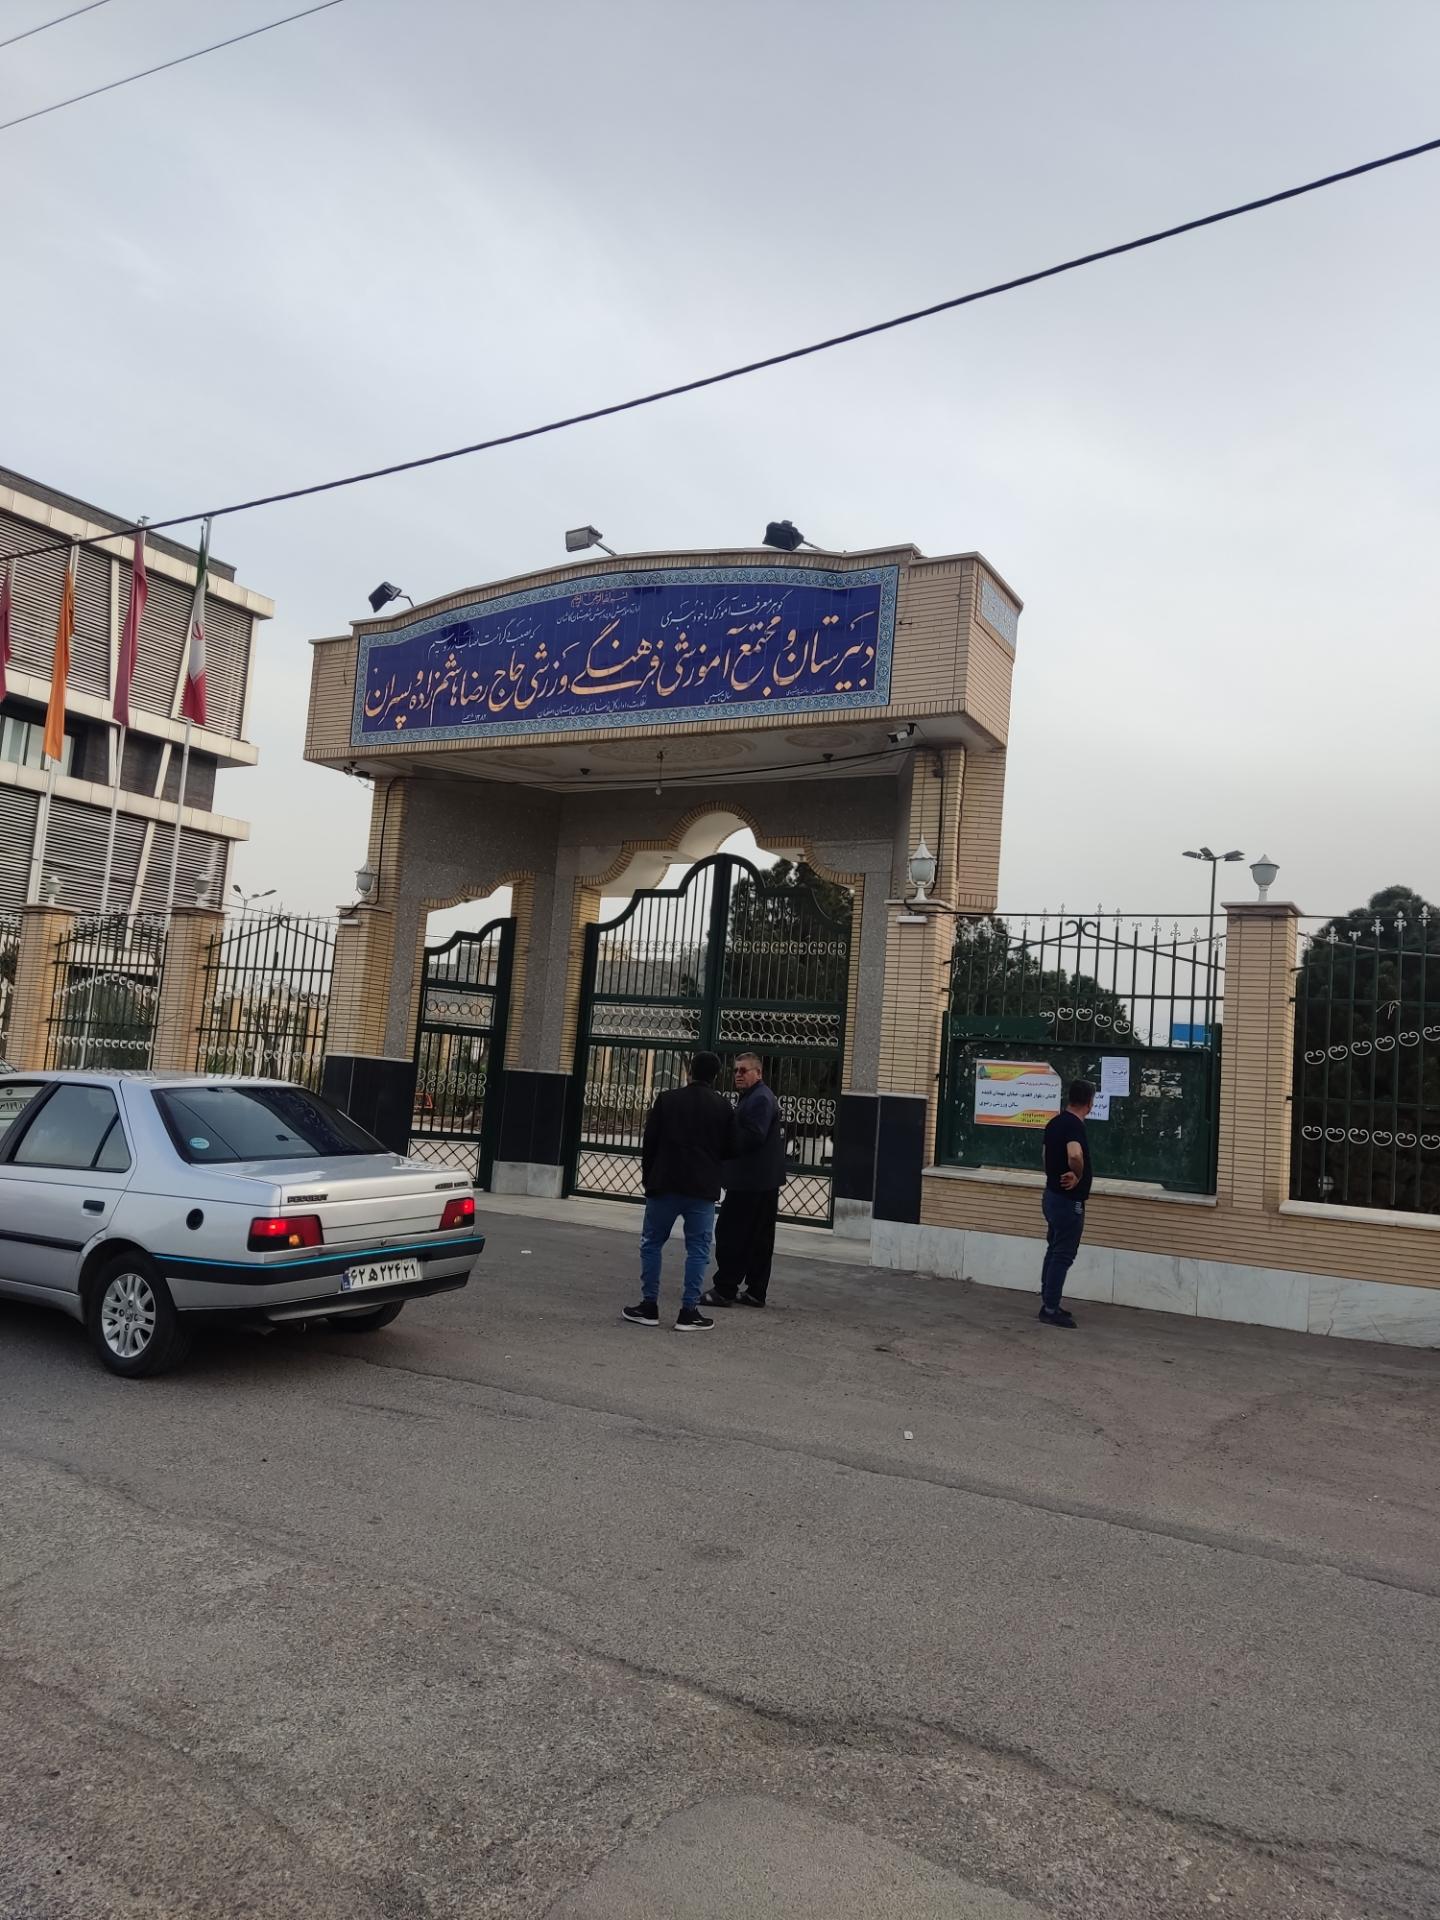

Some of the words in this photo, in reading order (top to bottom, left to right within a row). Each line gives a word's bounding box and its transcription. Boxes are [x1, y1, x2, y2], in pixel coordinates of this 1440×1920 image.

[708, 597, 728, 620] که
[731, 595, 772, 616] معرفت
[571, 618, 664, 695] فرهنگی
[657, 621, 747, 697] آموزشی
[731, 615, 782, 697] مجتمع
[773, 615, 875, 691] دبیرستان
[784, 628, 797, 651] و
[364, 672, 412, 730] پسران
[460, 670, 489, 704] رضا
[488, 650, 526, 712] حاج
[514, 642, 568, 710] ورزشی
